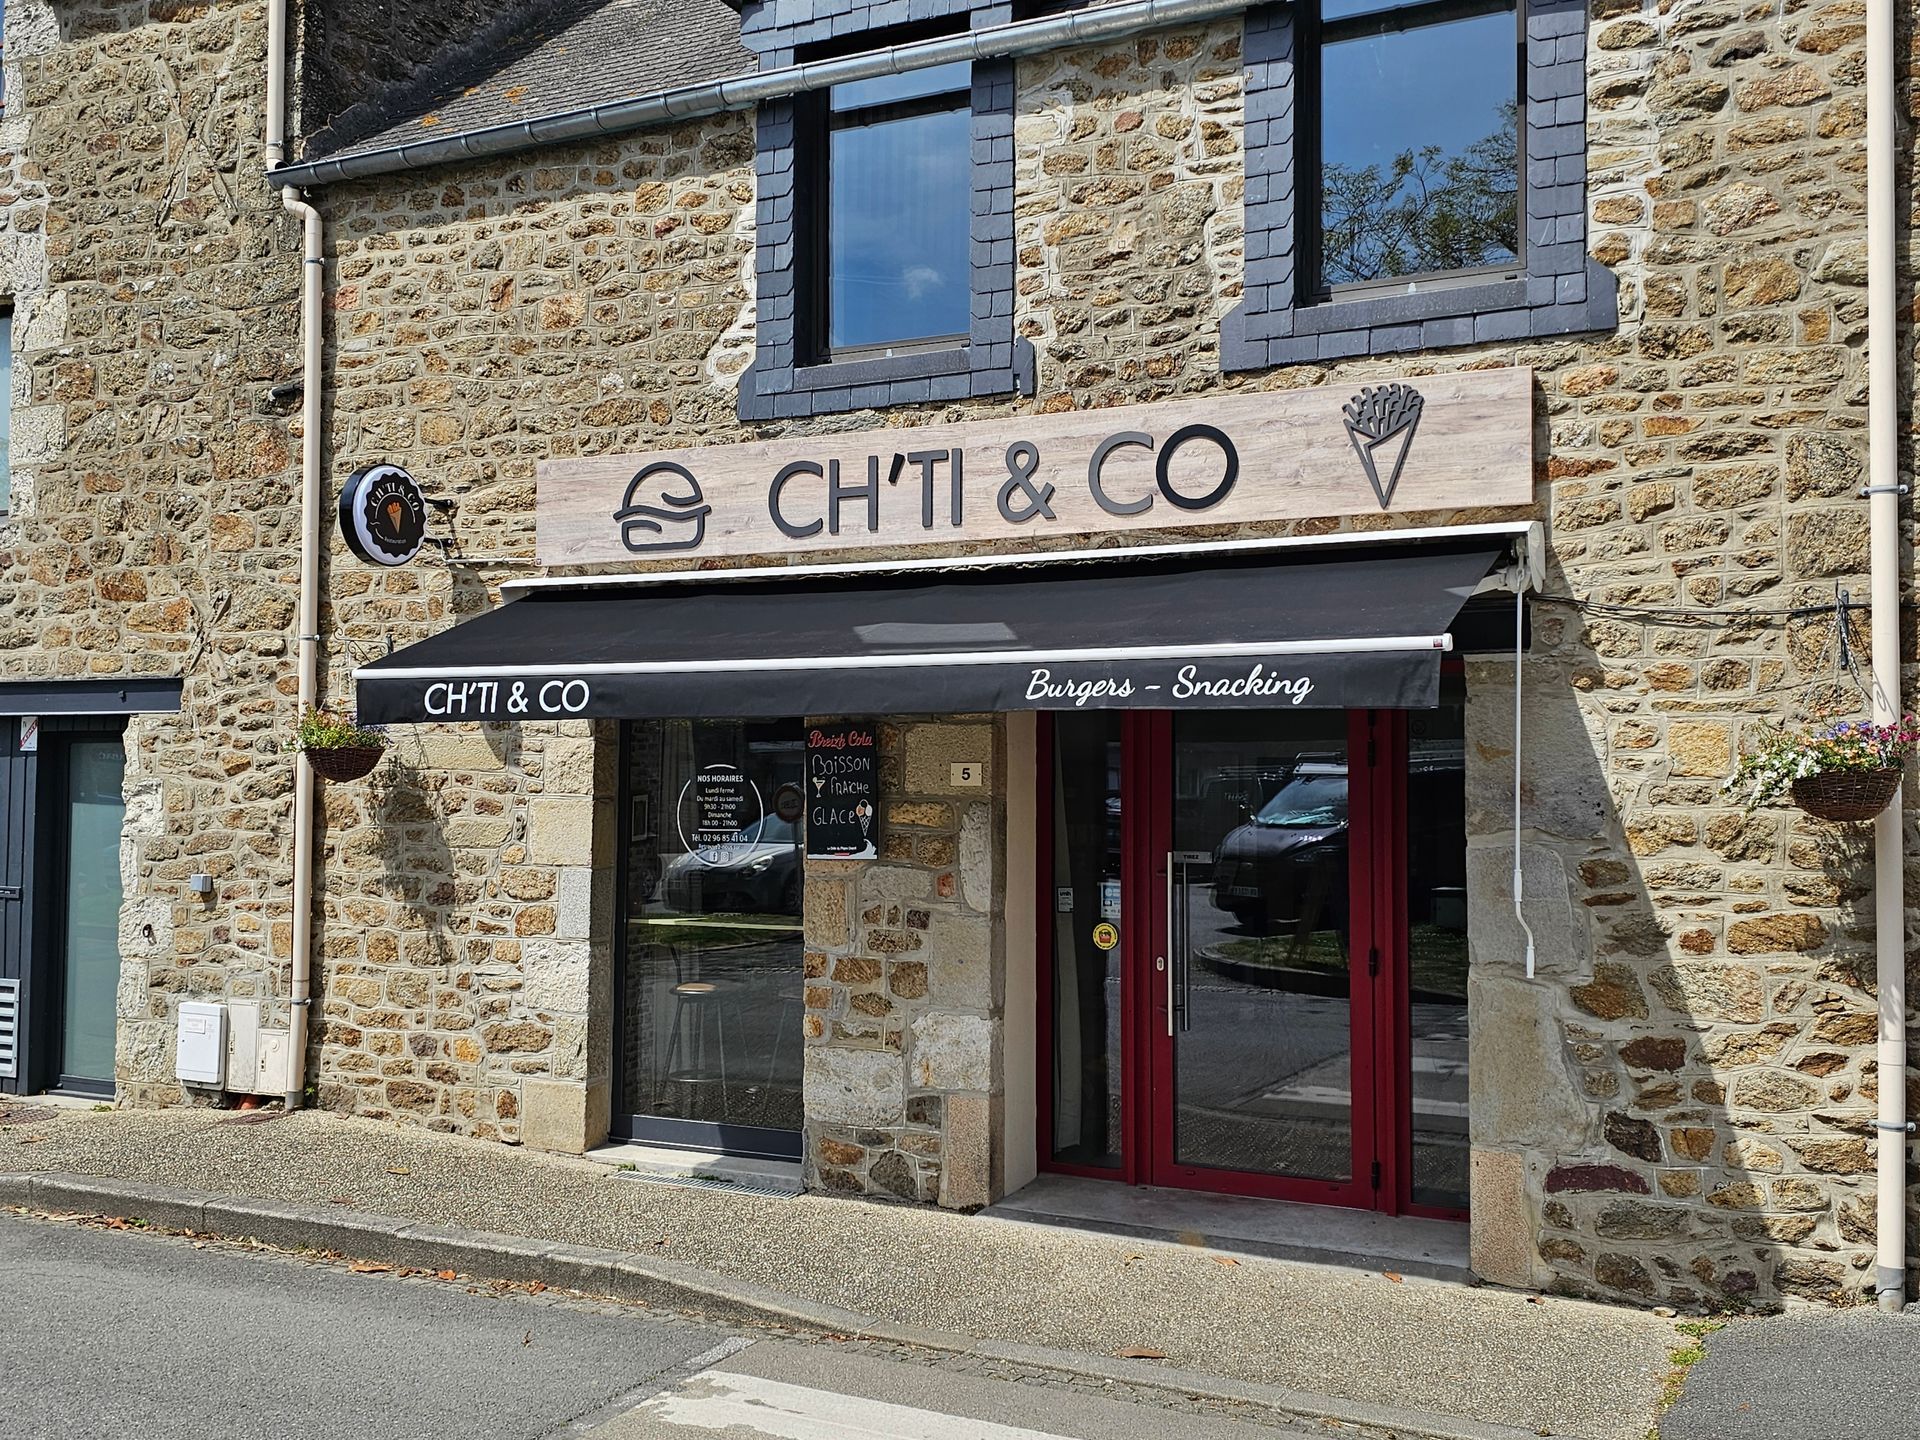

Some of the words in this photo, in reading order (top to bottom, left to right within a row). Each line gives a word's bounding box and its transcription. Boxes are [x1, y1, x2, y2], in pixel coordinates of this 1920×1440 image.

[768, 447, 963, 539] CH'TI
[996, 440, 1057, 523] &
[1088, 423, 1240, 516] CO
[371, 483, 395, 506] CH'TI
[398, 484, 405, 497] &
[408, 493, 419, 511] CO
[1025, 668, 1135, 706] Burgers
[1172, 663, 1315, 705] Snacking
[424, 681, 499, 715] CH'TI
[506, 680, 529, 714] &
[539, 679, 590, 713] CO
[808, 730, 846, 750] Breizh
[848, 730, 873, 747] Cola
[697, 774, 711, 783] NOS
[711, 774, 744, 783] HORAIRES
[961, 767, 971, 781] 5
[702, 833, 711, 842] 02
[711, 834, 721, 842] 96
[721, 834, 730, 842] 85
[739, 834, 748, 842] 04
